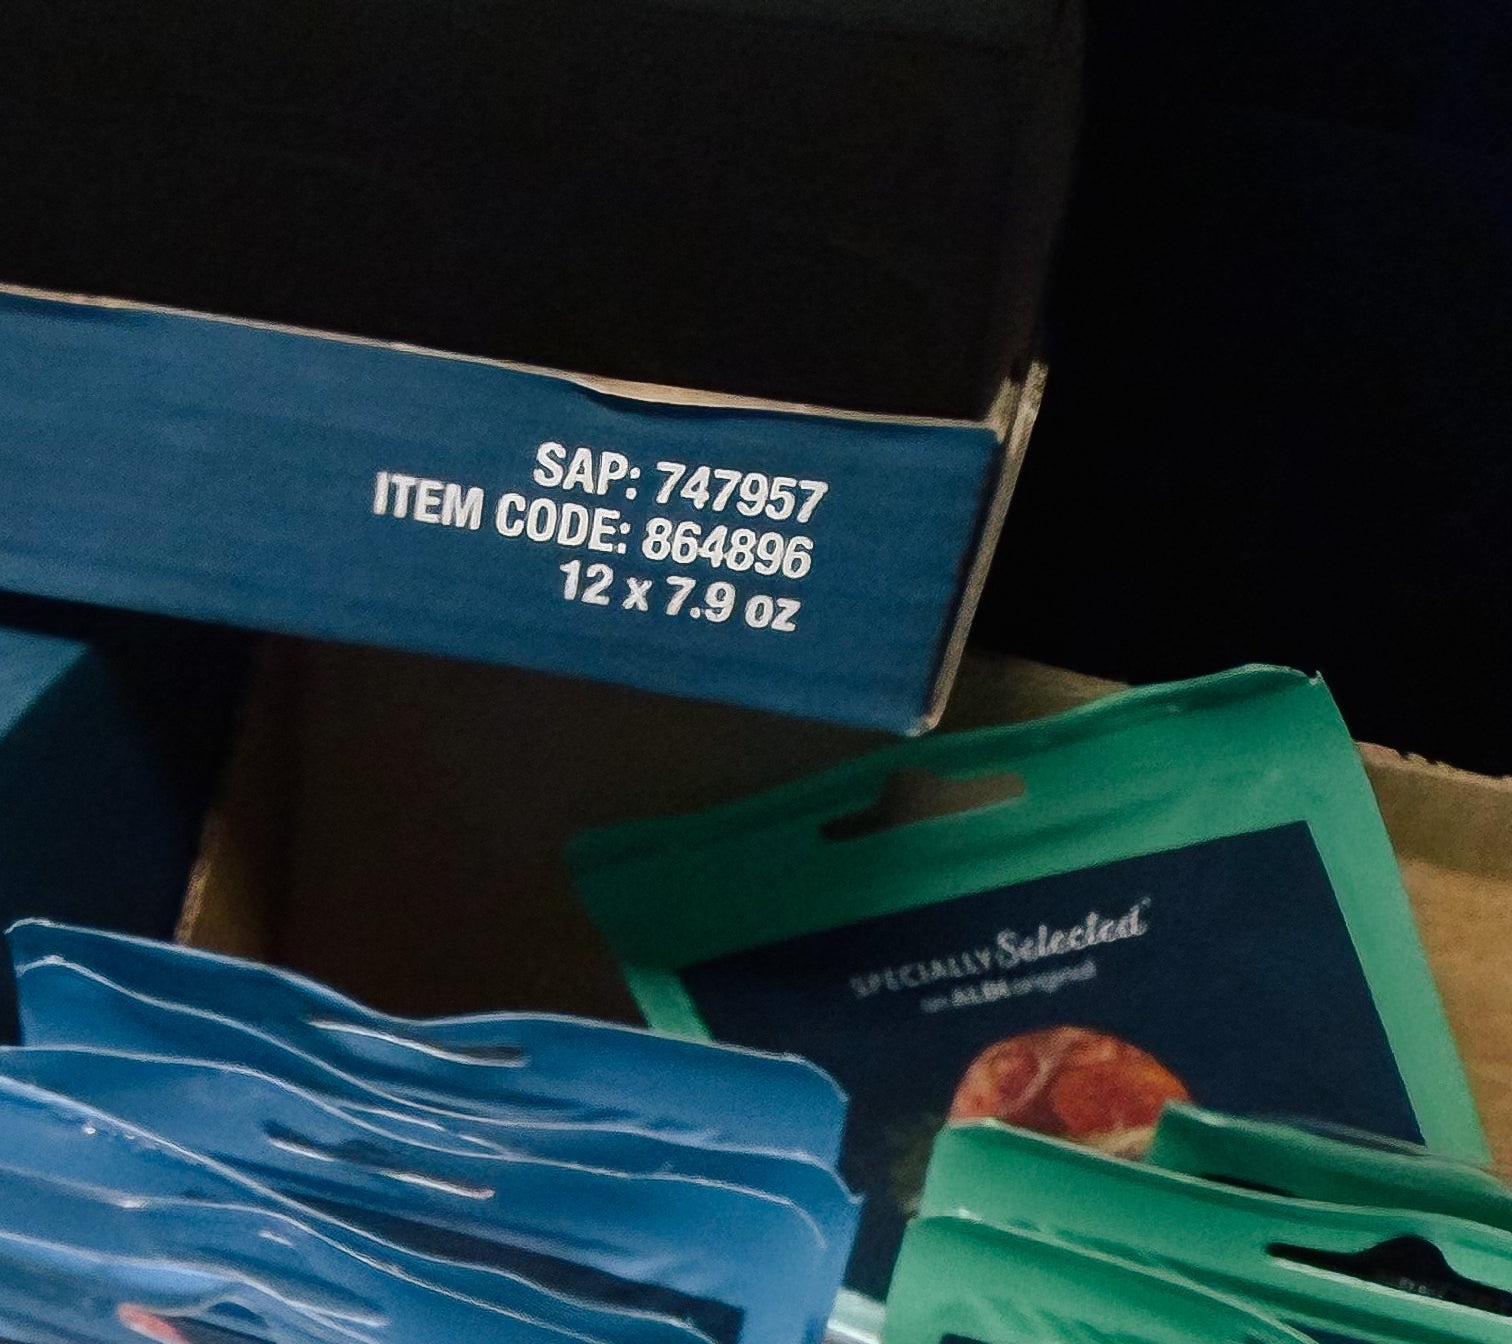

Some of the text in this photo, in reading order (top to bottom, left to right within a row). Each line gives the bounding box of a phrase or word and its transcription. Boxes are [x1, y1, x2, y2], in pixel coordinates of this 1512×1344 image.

[534, 441, 830, 524] SAP: 747957
[373, 470, 815, 580] ITEM CODE: 864896
[559, 560, 803, 633] 12 x 7.9 oz
[995, 900, 1150, 970] Selected
